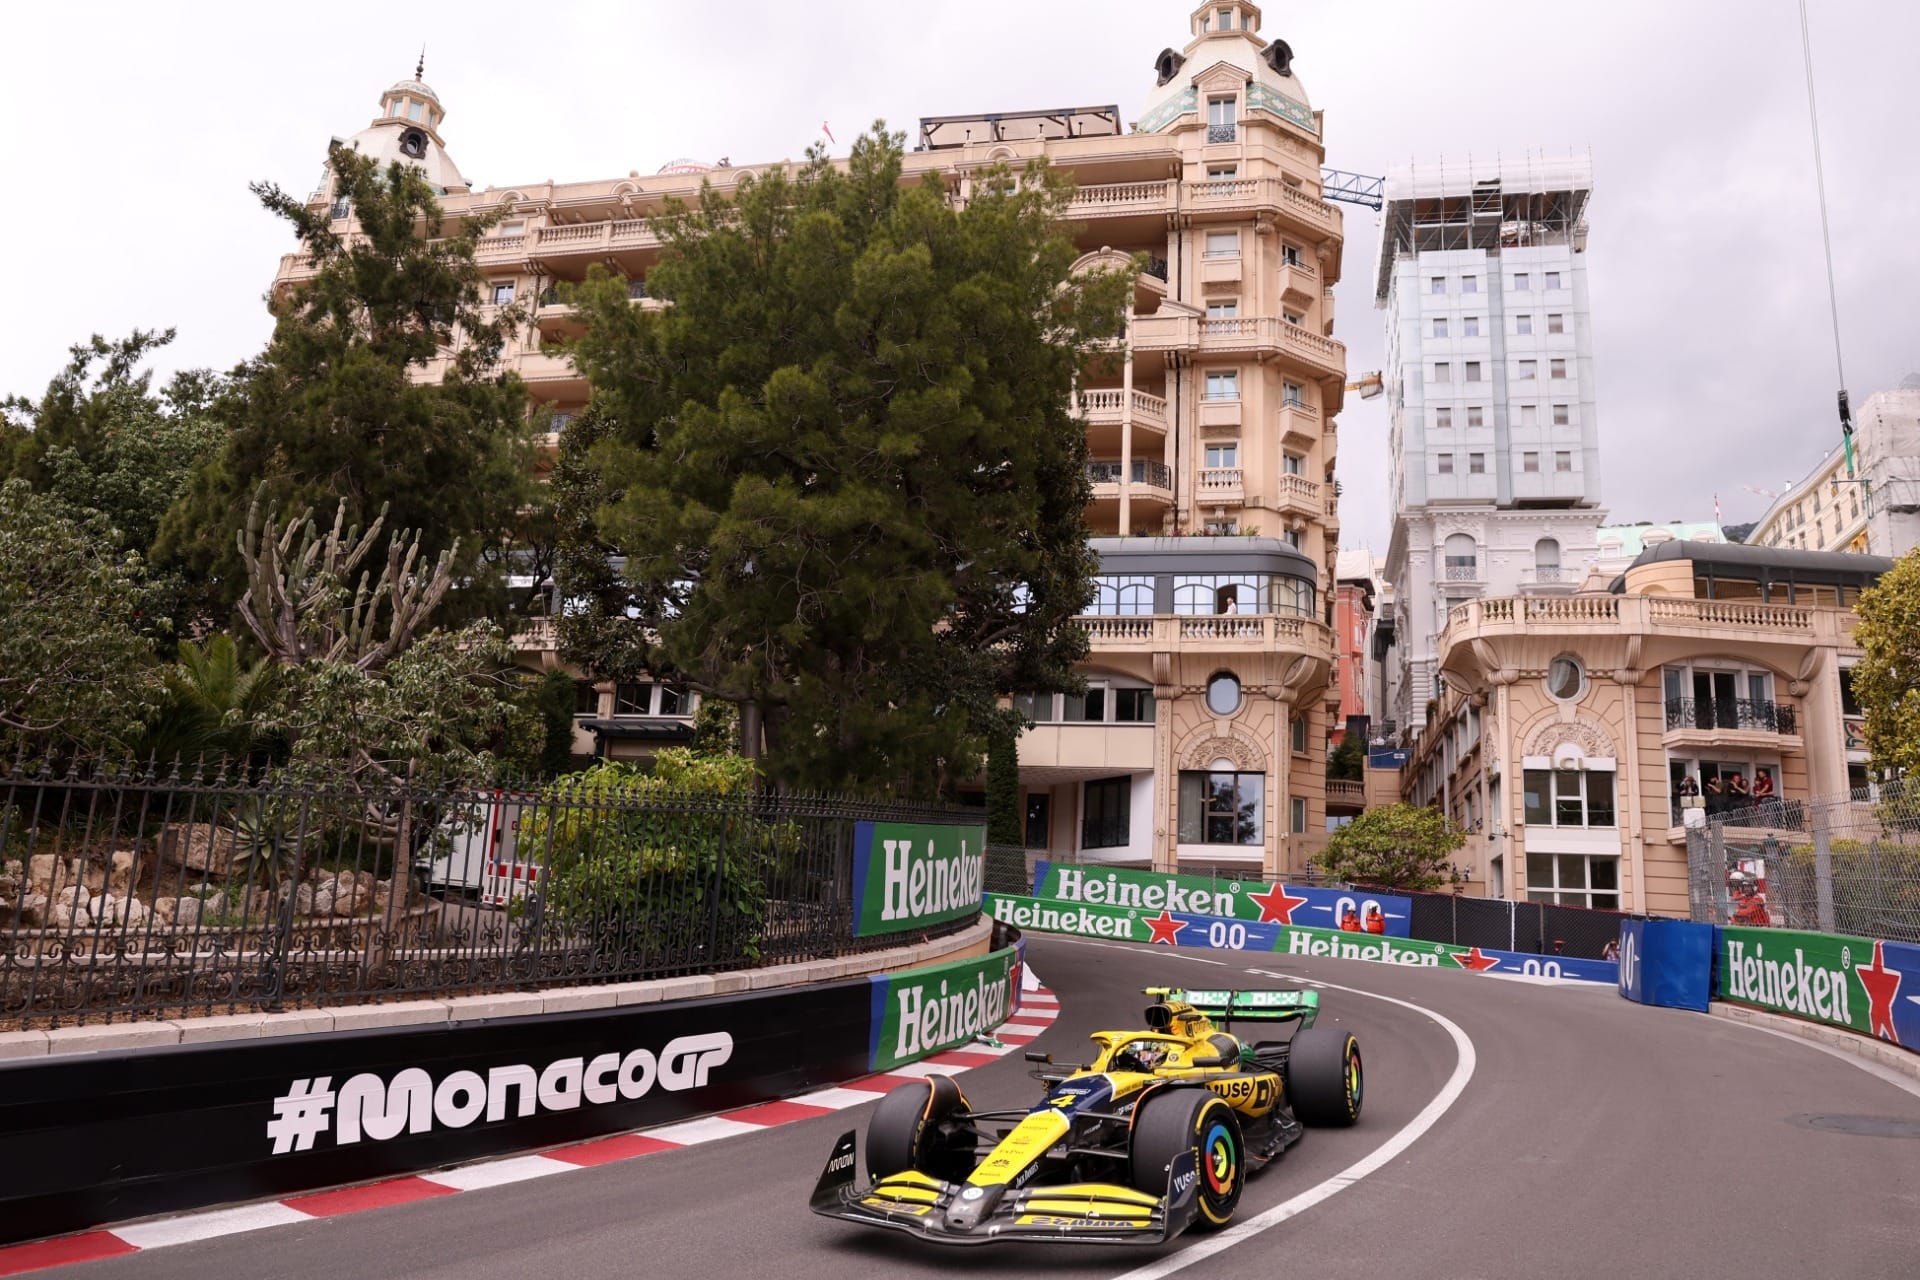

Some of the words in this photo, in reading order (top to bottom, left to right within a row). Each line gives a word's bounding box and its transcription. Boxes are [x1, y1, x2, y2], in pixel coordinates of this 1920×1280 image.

[1055, 868, 1236, 918] Heineken
[993, 898, 1133, 938] Heineken
[1209, 921, 1246, 950] 0.0
[1289, 930, 1440, 967] Heineken
[1728, 940, 1852, 1025] Heineken
[894, 972, 1006, 1060] Heineken
[1048, 1094, 1077, 1108] 4
